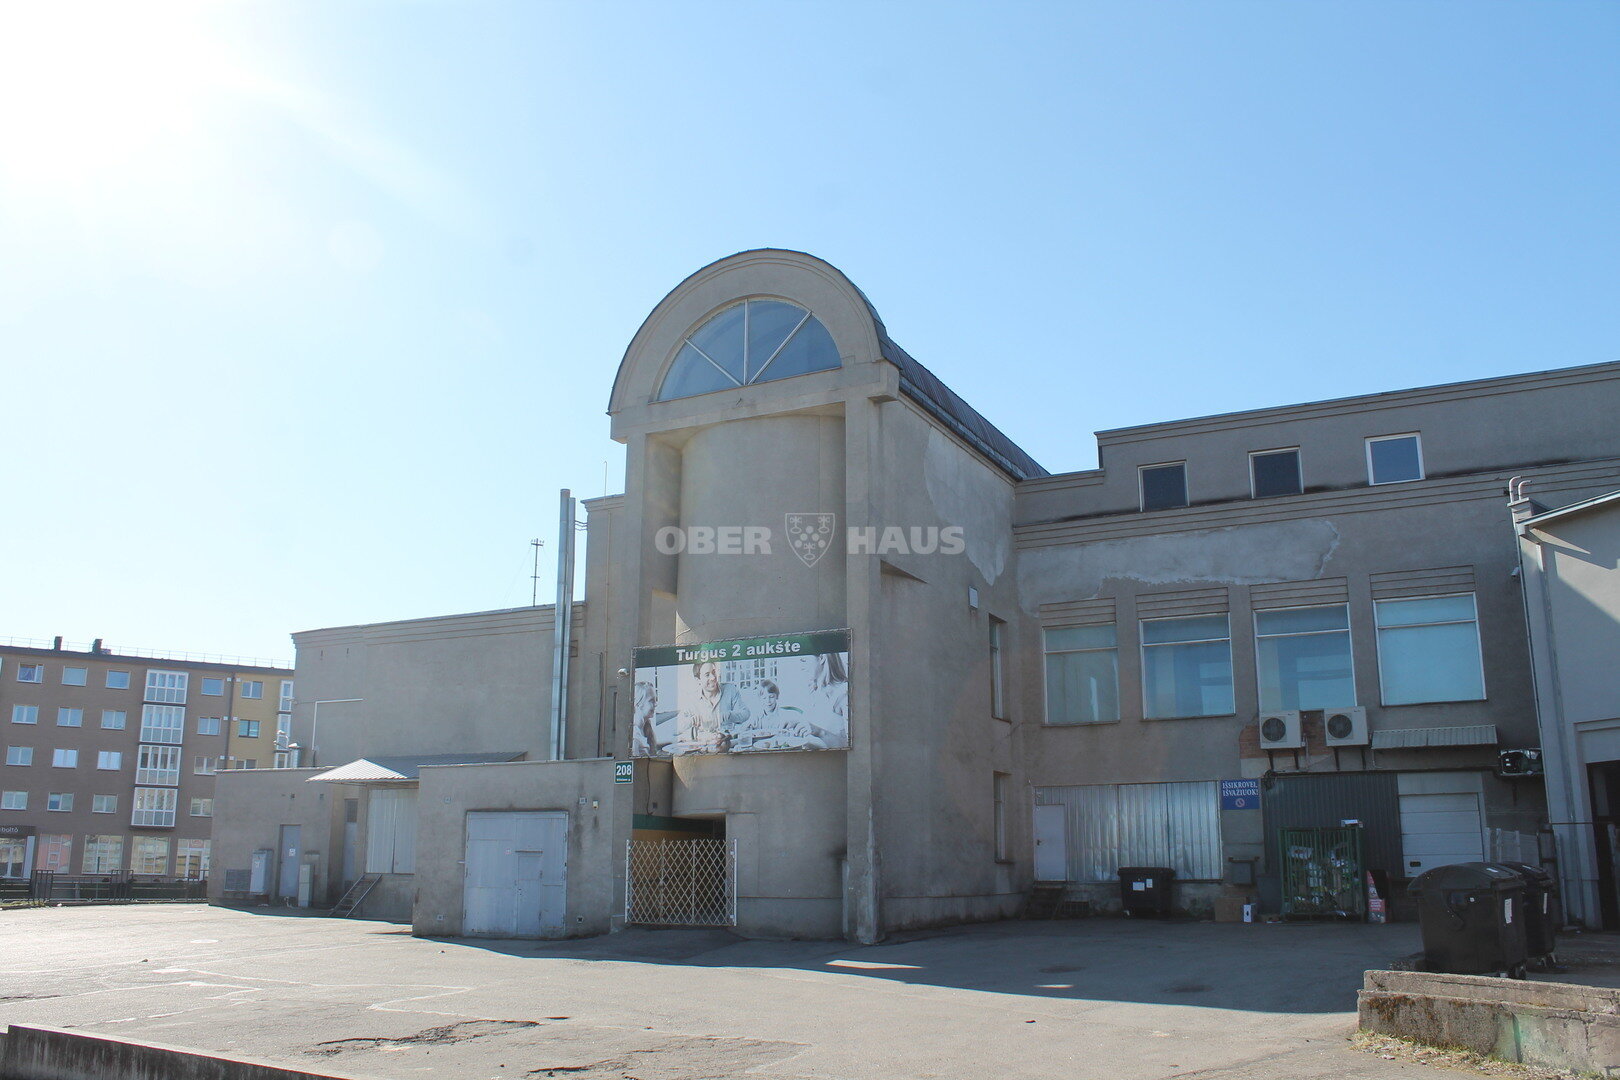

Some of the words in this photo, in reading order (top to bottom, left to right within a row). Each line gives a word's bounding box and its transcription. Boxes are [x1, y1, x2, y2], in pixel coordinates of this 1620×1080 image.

[676, 648, 727, 662] Turgus
[731, 644, 741, 657] 2
[746, 640, 801, 656] aukšte
[616, 765, 632, 776] 208
